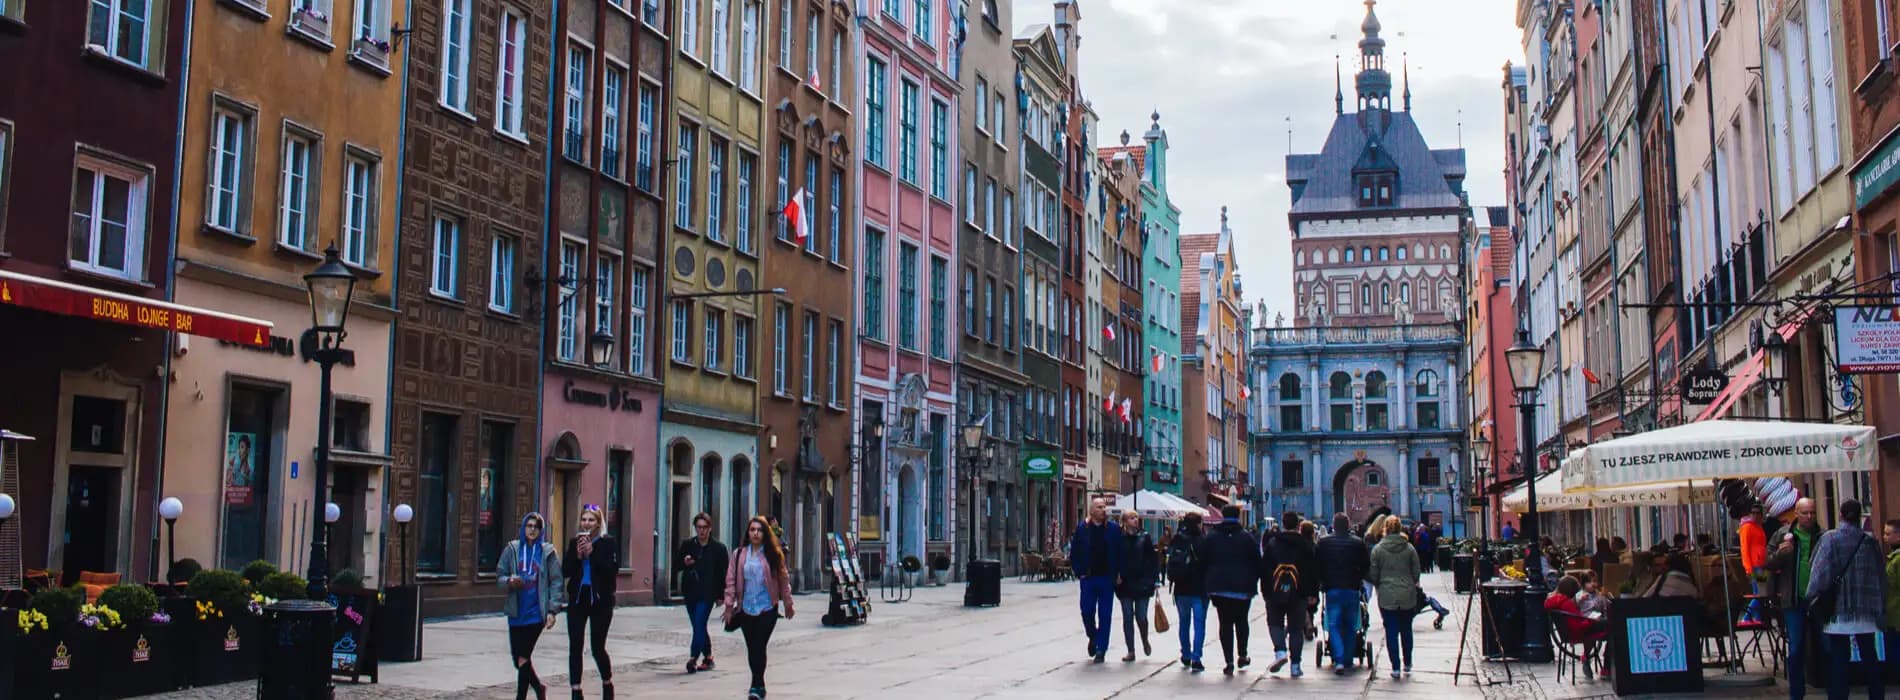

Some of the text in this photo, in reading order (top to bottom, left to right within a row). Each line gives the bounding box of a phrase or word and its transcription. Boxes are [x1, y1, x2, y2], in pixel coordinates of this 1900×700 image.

[93, 298, 129, 320] BUDDHA
[176, 313, 193, 331] BAR
[1692, 376, 1720, 389] Lody
[1601, 458, 1617, 469] TU
[1619, 454, 1656, 467] ZJESZ
[1658, 448, 1731, 463] PRAWDZIWE
[1740, 445, 1793, 458] ZDROWE
[1796, 444, 1829, 456] LODY
[1609, 486, 1668, 503] GRYCAN
